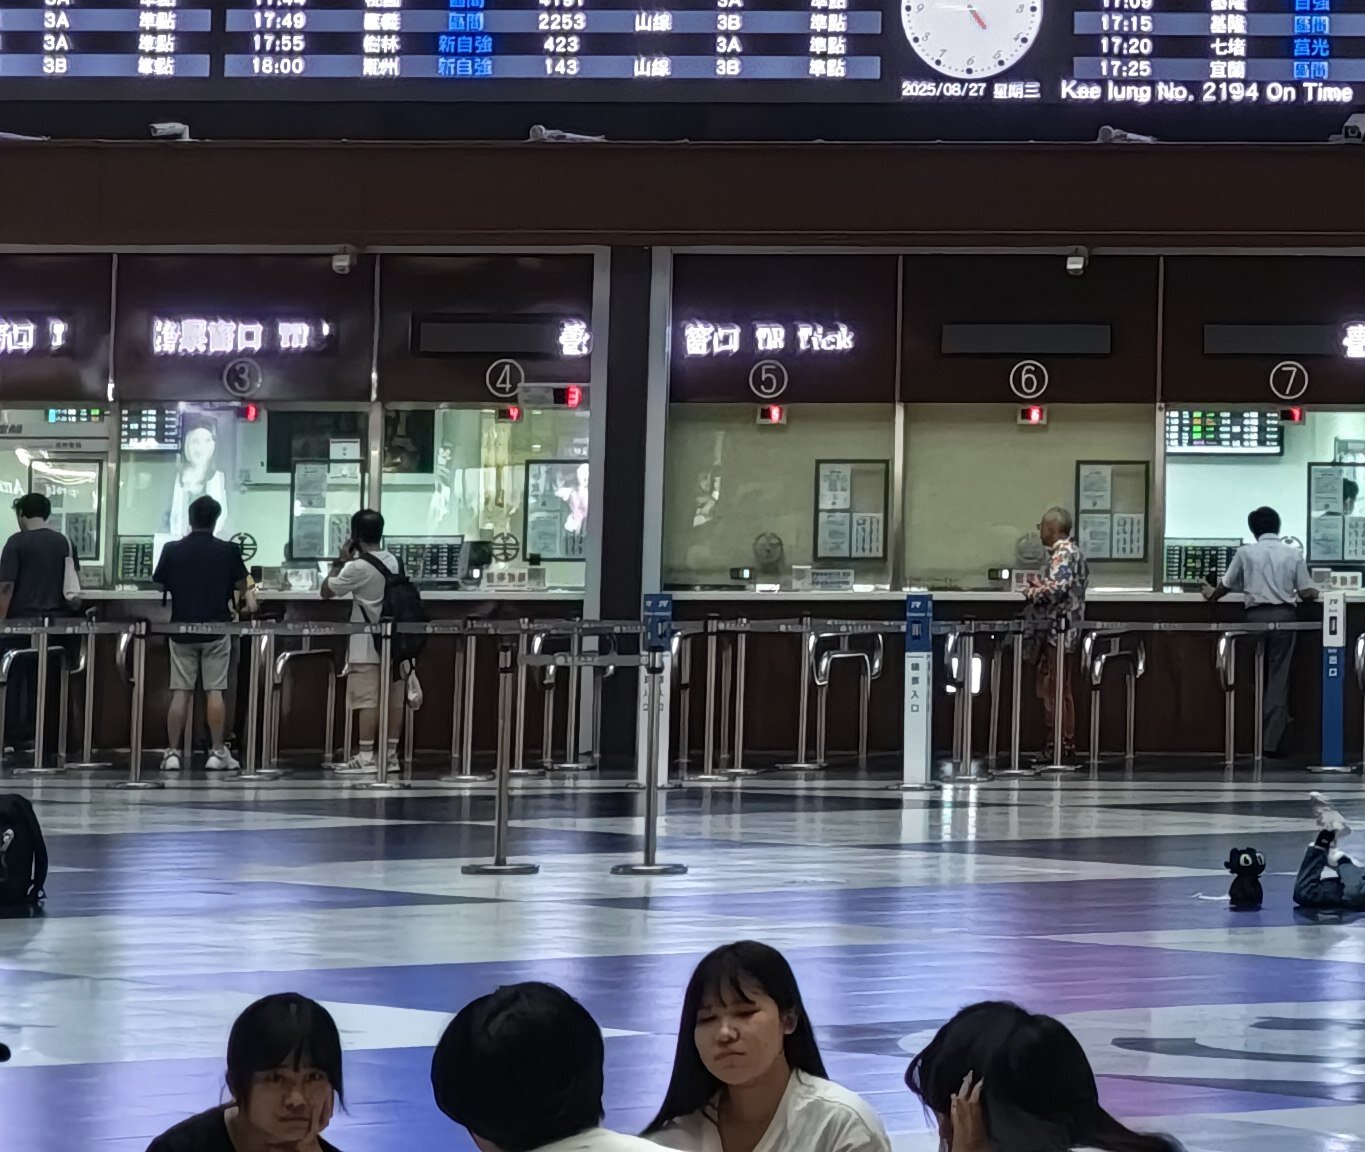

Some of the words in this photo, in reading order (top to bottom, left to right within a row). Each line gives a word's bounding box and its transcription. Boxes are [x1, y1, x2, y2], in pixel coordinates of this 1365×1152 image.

[254, 11, 306, 29] 17:49
[538, 12, 586, 30] 2253
[716, 14, 741, 31] 3B
[1101, 14, 1153, 32] 17:15
[253, 34, 305, 51] 17:55
[543, 36, 579, 53] 423
[716, 36, 741, 53] 3A
[1101, 36, 1152, 55] 17:20
[252, 56, 305, 74] 18:00
[545, 58, 578, 75] 143
[716, 59, 741, 75] 3B
[1100, 60, 1151, 77] 17:25
[901, 81, 987, 97] 2025/08/27
[1202, 81, 1259, 102] 2194
[1266, 82, 1296, 102] On
[1302, 81, 1354, 102] Time
